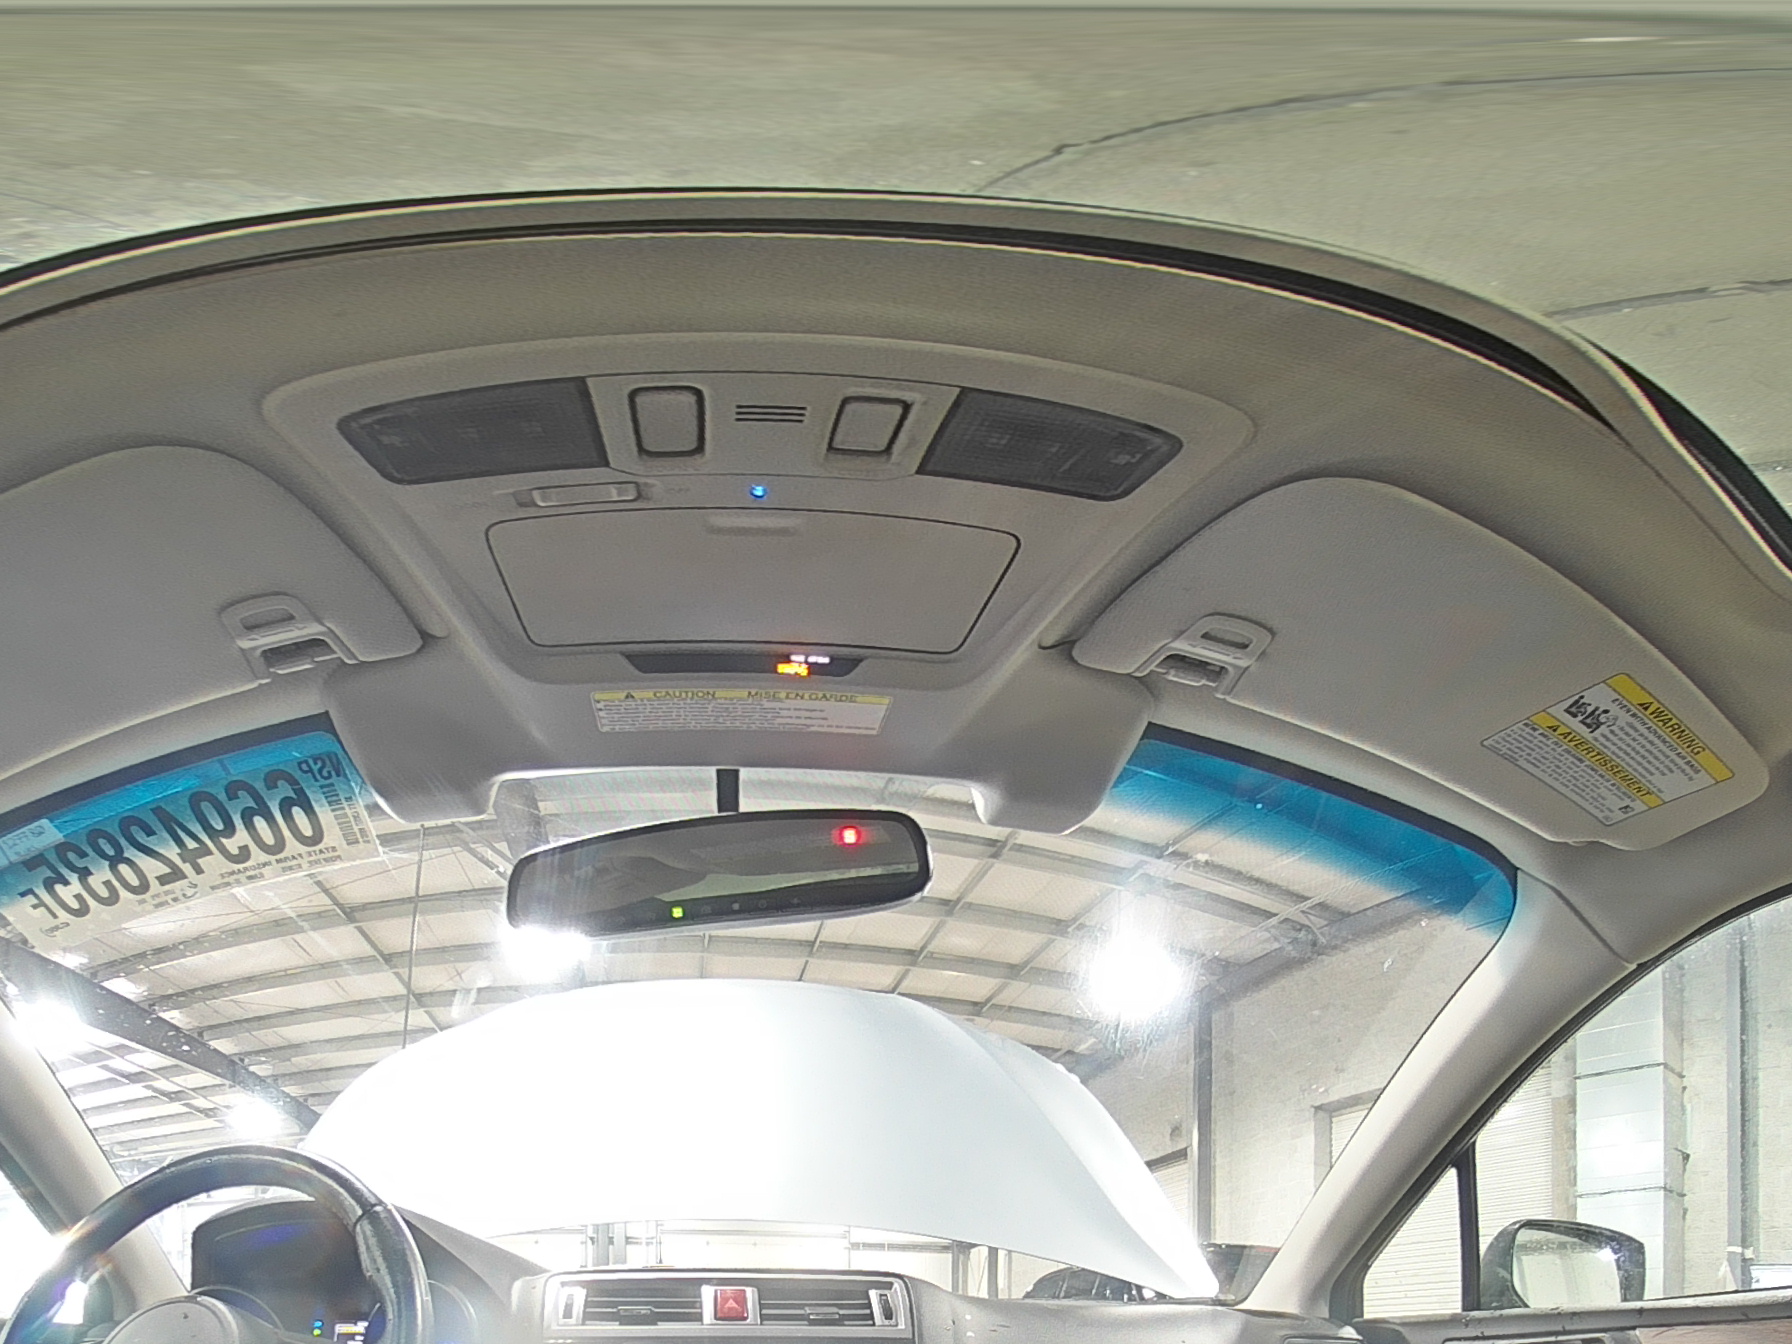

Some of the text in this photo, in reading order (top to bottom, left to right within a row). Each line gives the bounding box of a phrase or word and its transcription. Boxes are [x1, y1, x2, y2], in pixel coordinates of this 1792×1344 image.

[653, 690, 716, 699] CAUTION
[1648, 706, 1706, 756] WARNING
[1558, 730, 1653, 798] AVERTISSEMENT
